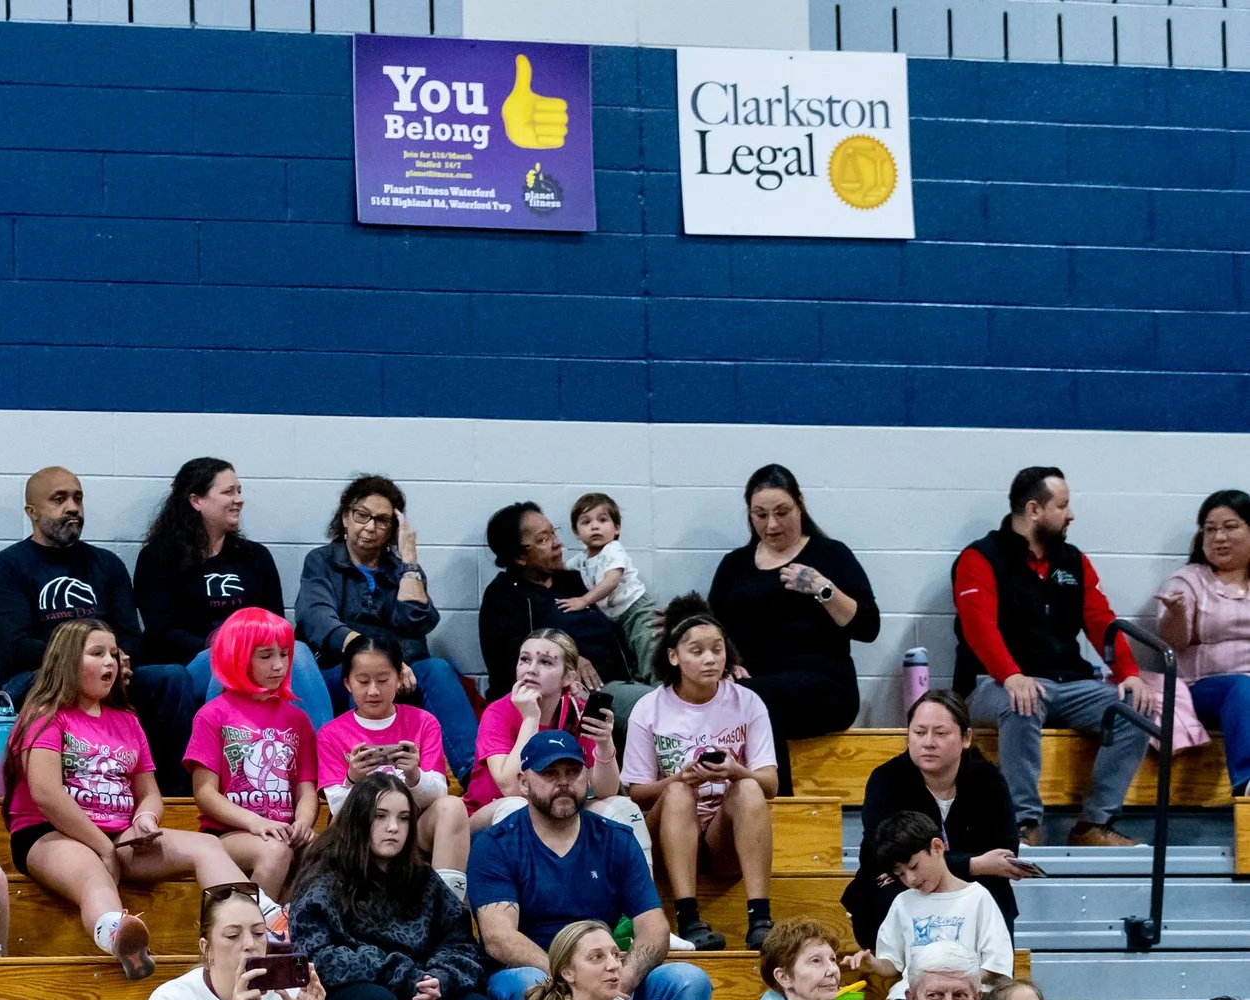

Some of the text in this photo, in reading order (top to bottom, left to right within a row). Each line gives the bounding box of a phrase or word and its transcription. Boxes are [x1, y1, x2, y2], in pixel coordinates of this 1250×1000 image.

[382, 65, 489, 114] You
[691, 81, 892, 129] Clarkston
[384, 114, 491, 150] Belong
[694, 130, 819, 191] Legal
[370, 196, 391, 206] 5142
[392, 197, 432, 208] Highland
[449, 200, 491, 210] Waterford
[492, 201, 511, 213] Twp
[383, 184, 496, 198] Planet Fitness Waterford
[524, 190, 555, 201] planet
[529, 199, 562, 208] fitness
[653, 723, 747, 751] PIERCE VS MASON
